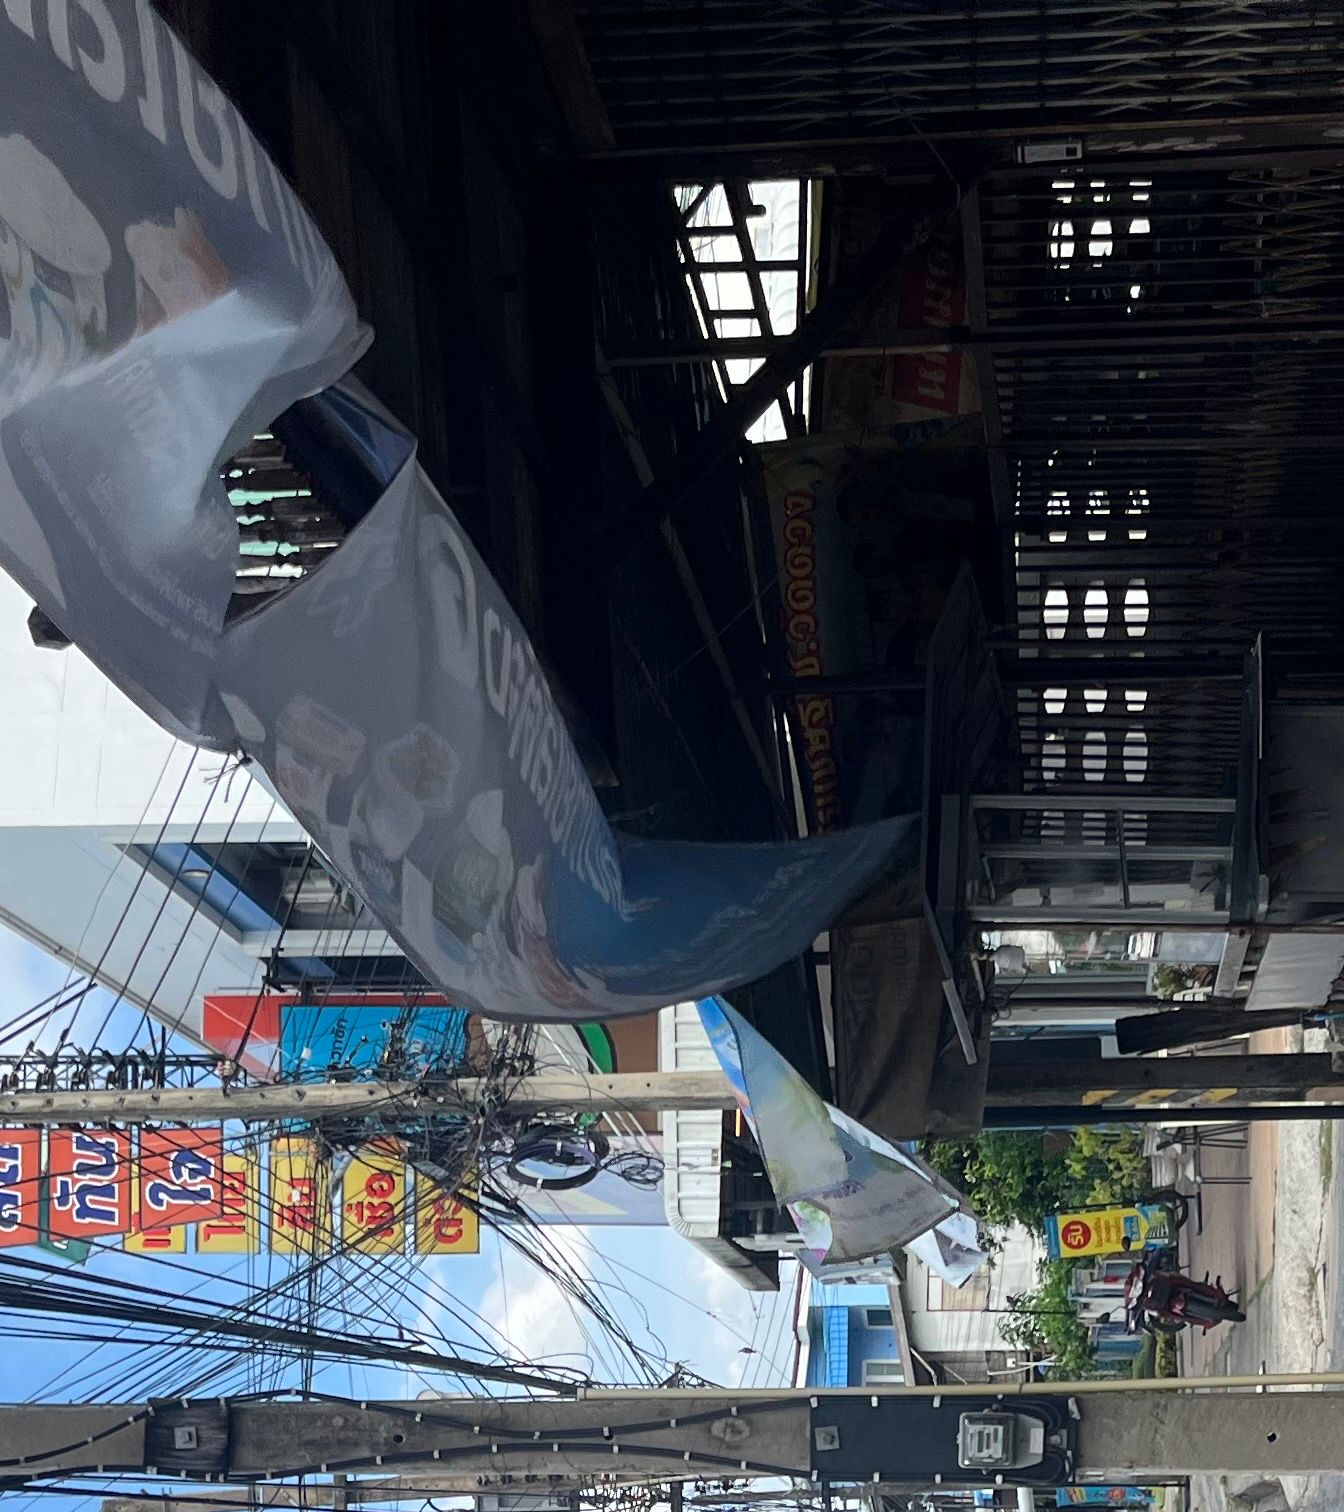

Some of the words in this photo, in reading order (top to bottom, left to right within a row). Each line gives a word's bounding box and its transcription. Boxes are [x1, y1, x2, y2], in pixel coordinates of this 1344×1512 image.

[54, 1132, 119, 1225] ทัน
[145, 1148, 214, 1210] ใจ
[423, 1195, 463, 1244] ด่ว
